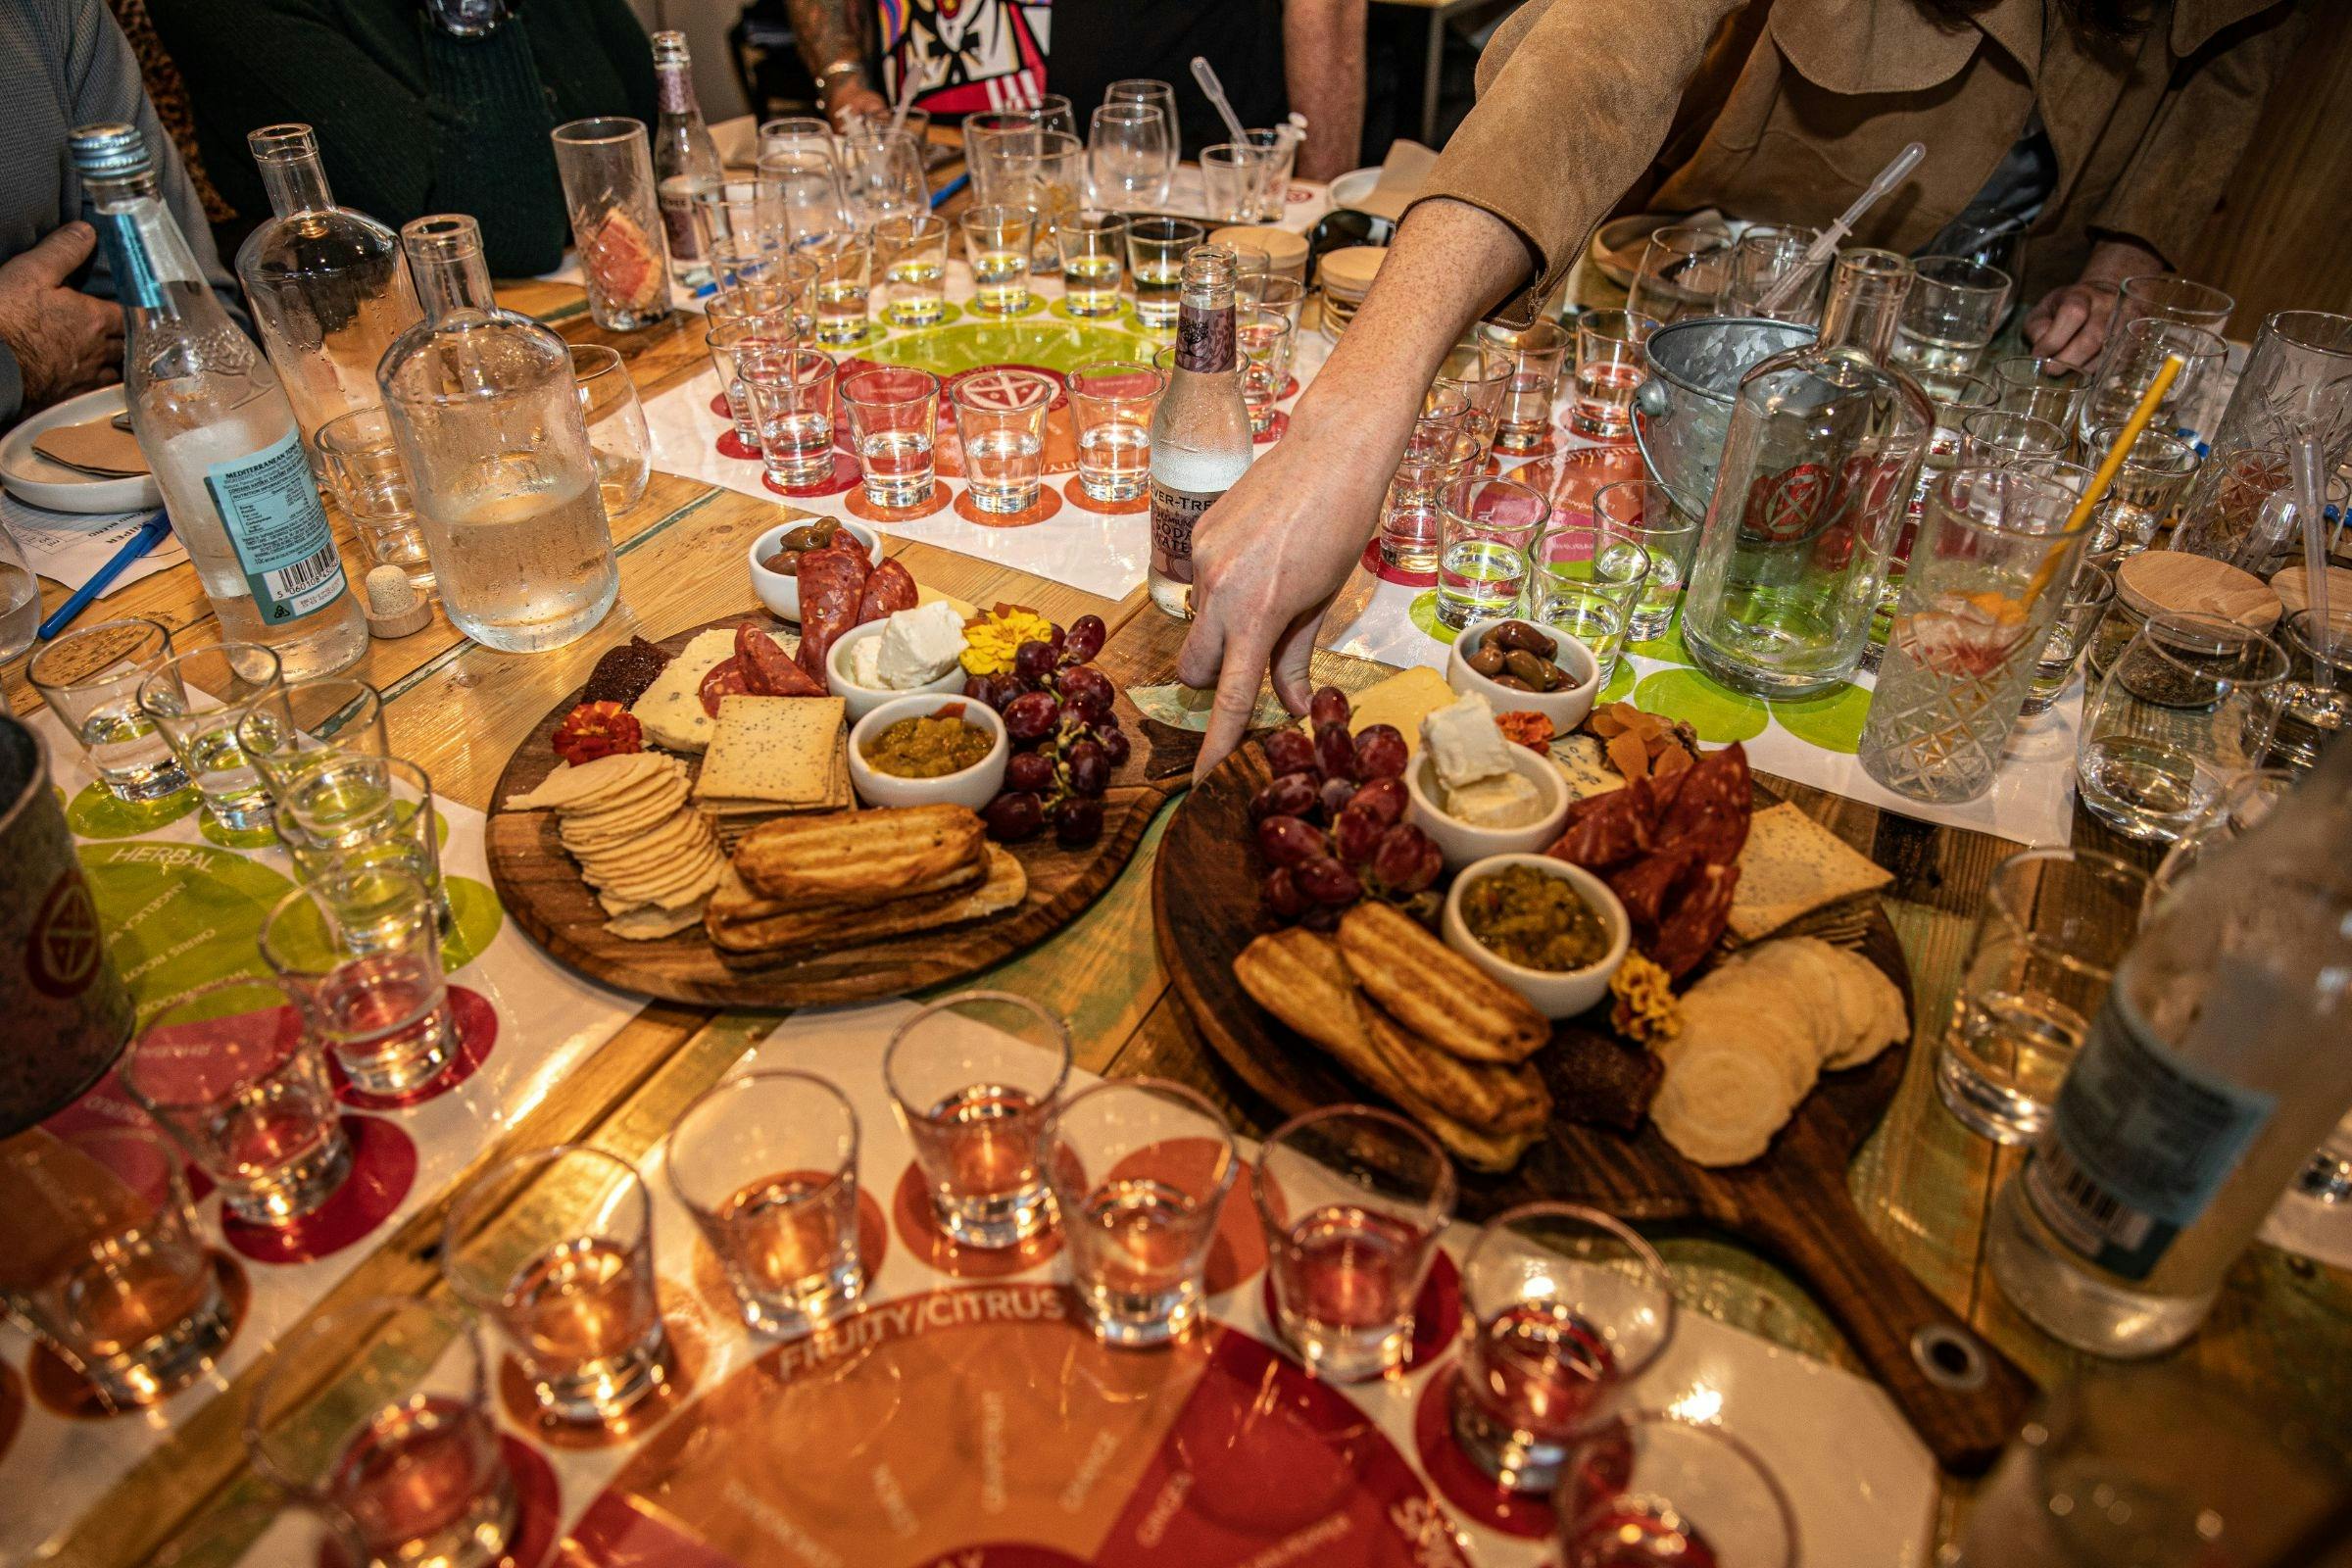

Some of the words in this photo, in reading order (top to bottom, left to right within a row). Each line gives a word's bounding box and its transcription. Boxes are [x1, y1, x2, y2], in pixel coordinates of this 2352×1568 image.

[225, 454, 285, 480] MEDITERRANEAN
[1151, 482, 1217, 511] EVER-TRE
[1155, 531, 1193, 554] WATE
[1156, 518, 1193, 541] SODA
[277, 590, 284, 599] 5
[289, 575, 320, 595] 060108
[109, 846, 217, 873] HERBAL
[778, 1288, 1065, 1382] FRUITY/CITRUS
